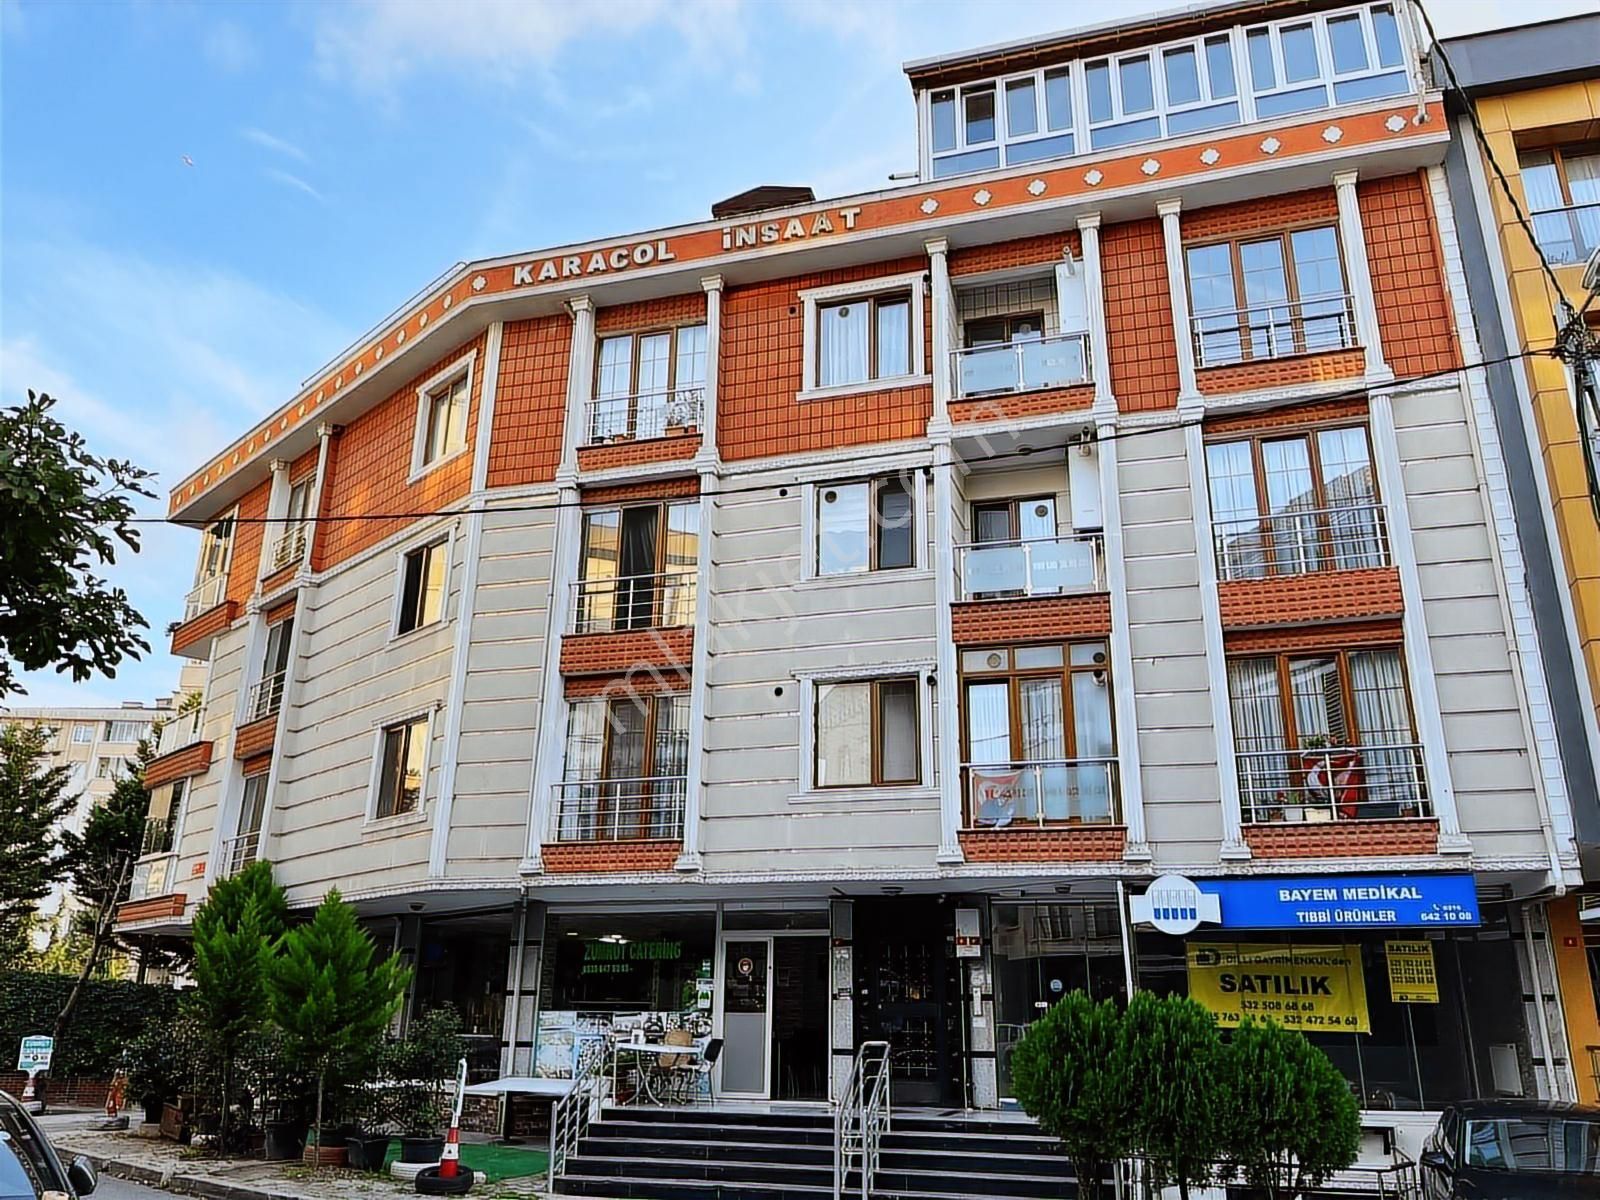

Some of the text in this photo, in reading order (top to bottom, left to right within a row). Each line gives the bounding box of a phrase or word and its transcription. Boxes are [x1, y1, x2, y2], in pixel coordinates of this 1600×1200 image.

[512, 240, 676, 287] KARACOL
[1279, 885, 1423, 902] BAYEM MEDİKAL
[1296, 908, 1397, 923] TIBBİ ÜRÜNLER
[1420, 913, 1441, 922] 642
[1443, 913, 1456, 921] 10
[1219, 973, 1333, 996] SATILIK
[1284, 1014, 1302, 1024] 532
[1306, 1015, 1325, 1025] 472
[1328, 1015, 1341, 1025] 54
